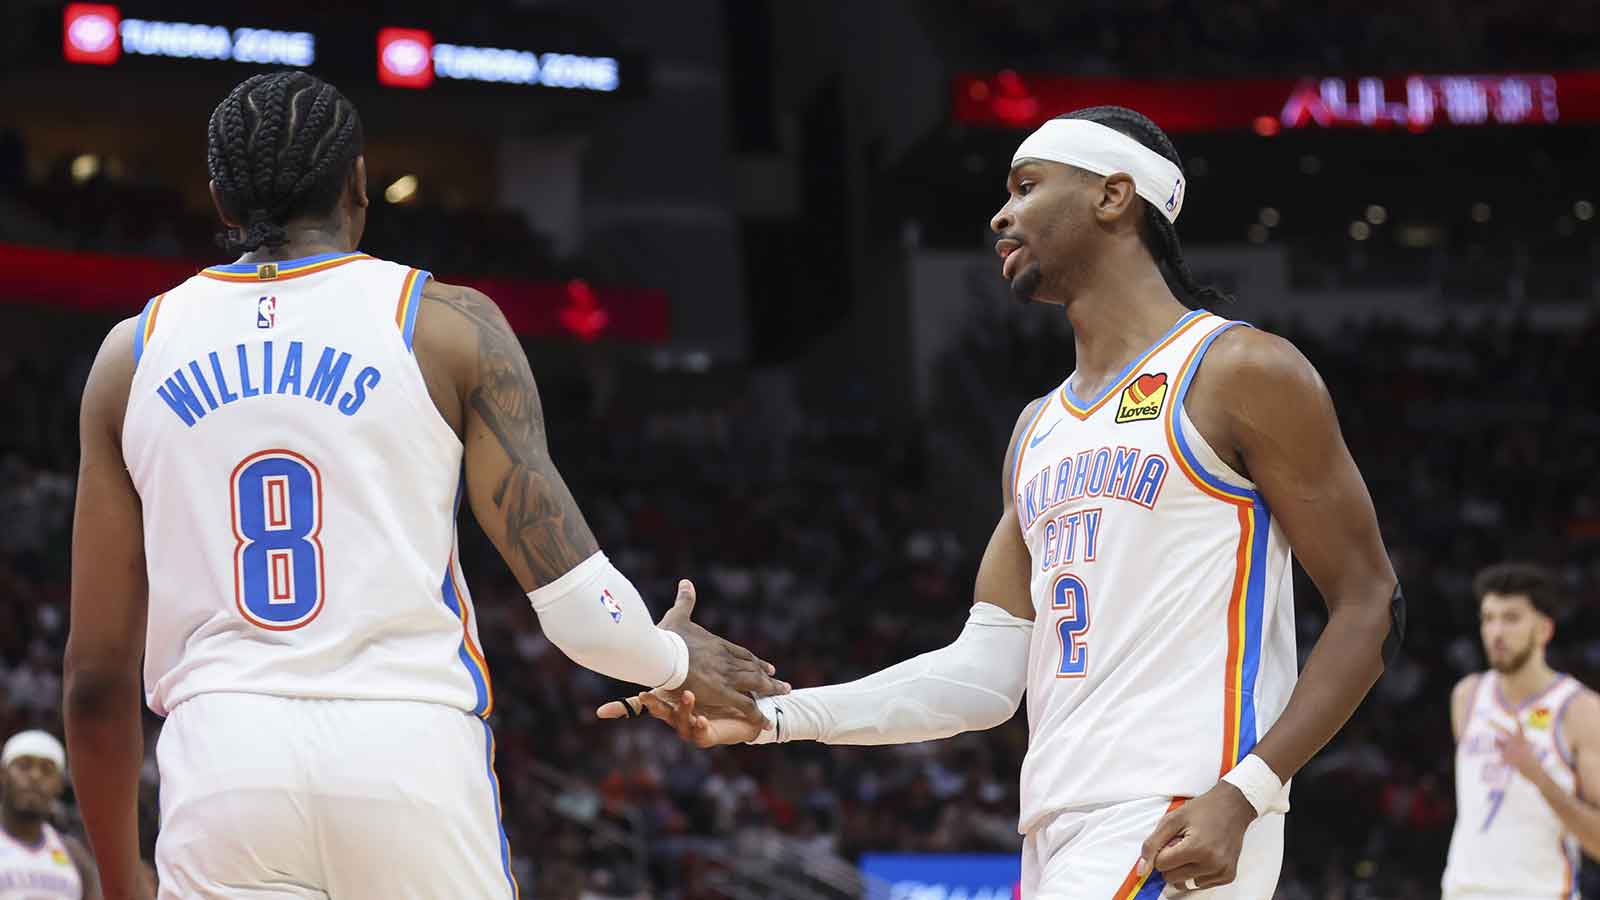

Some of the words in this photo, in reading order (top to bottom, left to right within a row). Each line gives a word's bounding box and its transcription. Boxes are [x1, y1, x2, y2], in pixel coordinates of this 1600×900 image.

[156, 341, 381, 427] WILLIAMS
[1119, 401, 1158, 418] Love's
[229, 448, 325, 631] 8
[1042, 508, 1102, 572] CITY
[1052, 573, 1090, 678] 2
[1480, 788, 1505, 833] 7
